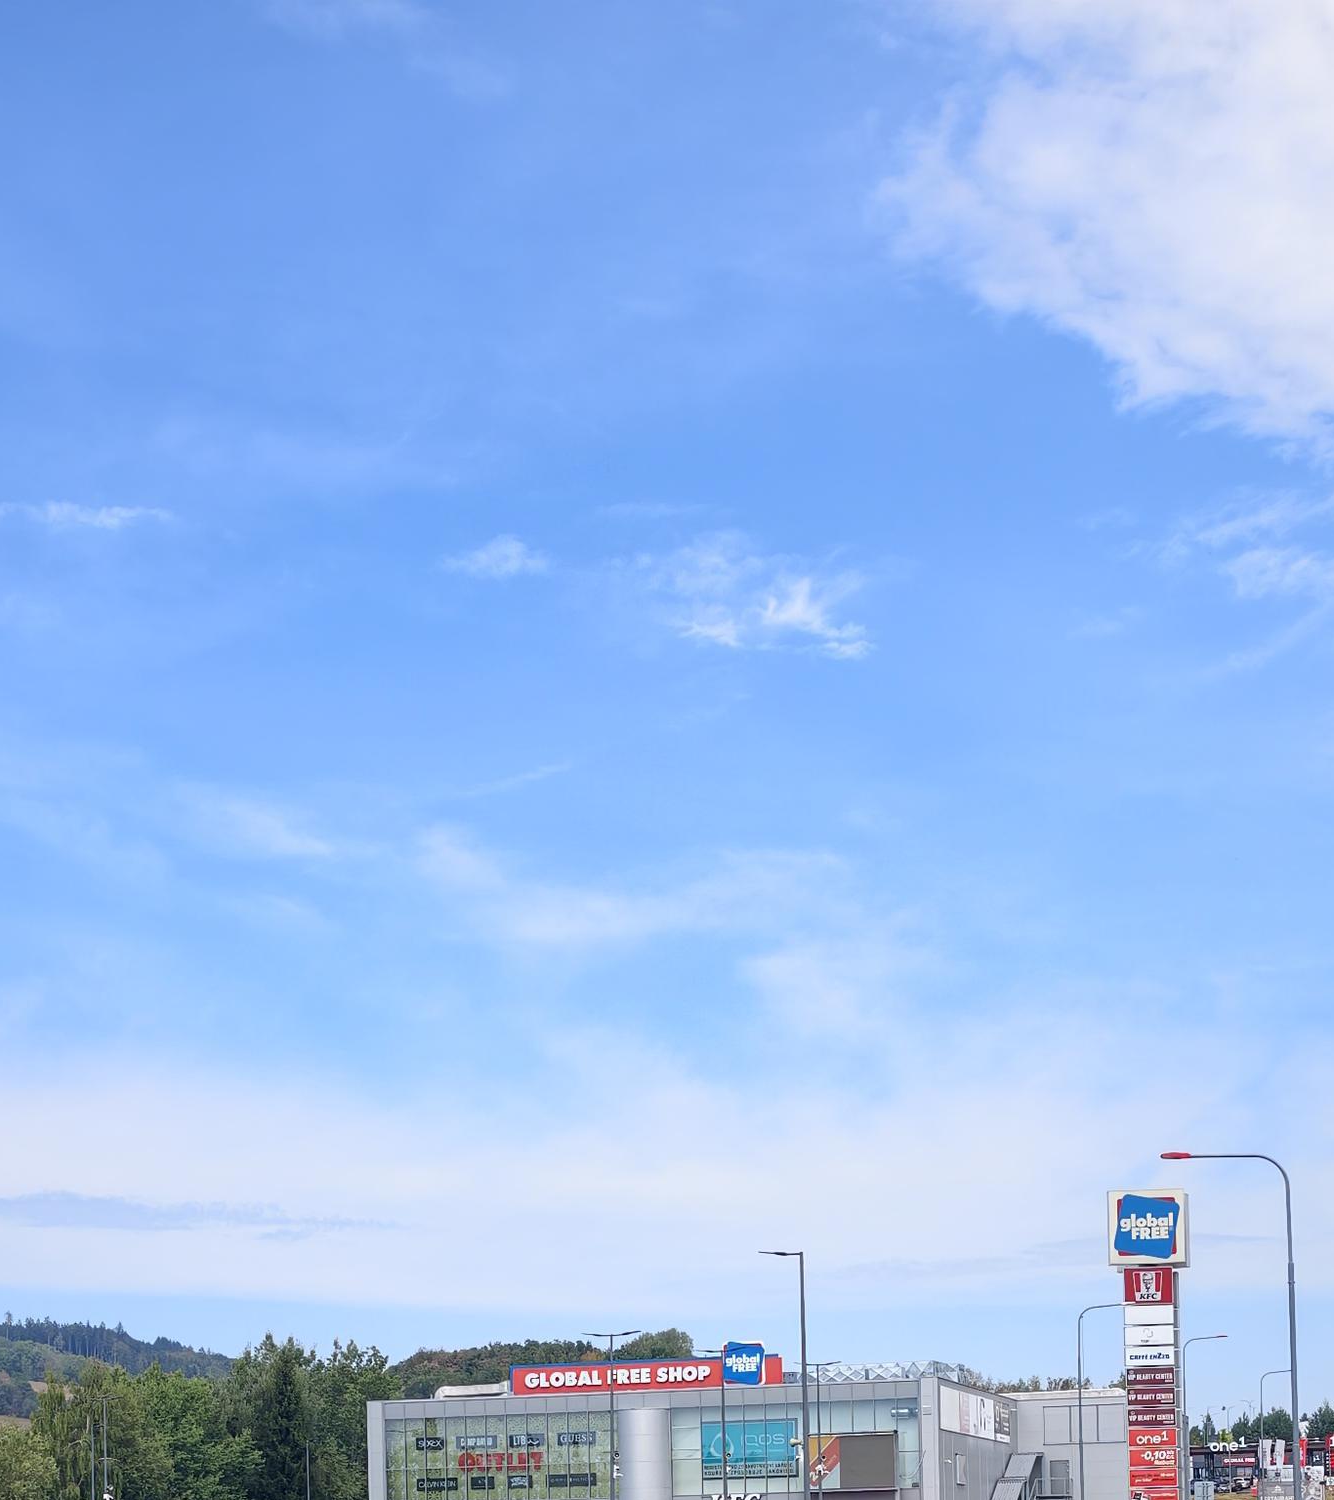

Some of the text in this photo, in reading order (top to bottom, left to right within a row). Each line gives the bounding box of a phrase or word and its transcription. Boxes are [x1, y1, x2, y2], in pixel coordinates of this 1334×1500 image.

[1120, 1212, 1173, 1232] global
[1131, 1227, 1169, 1240] FREE
[725, 1353, 760, 1367] global
[732, 1363, 757, 1373] FREE
[525, 1365, 711, 1388] GLOBAL FREE SHOP
[560, 1433, 593, 1443] GUESS
[458, 1451, 543, 1472] OUTLET
